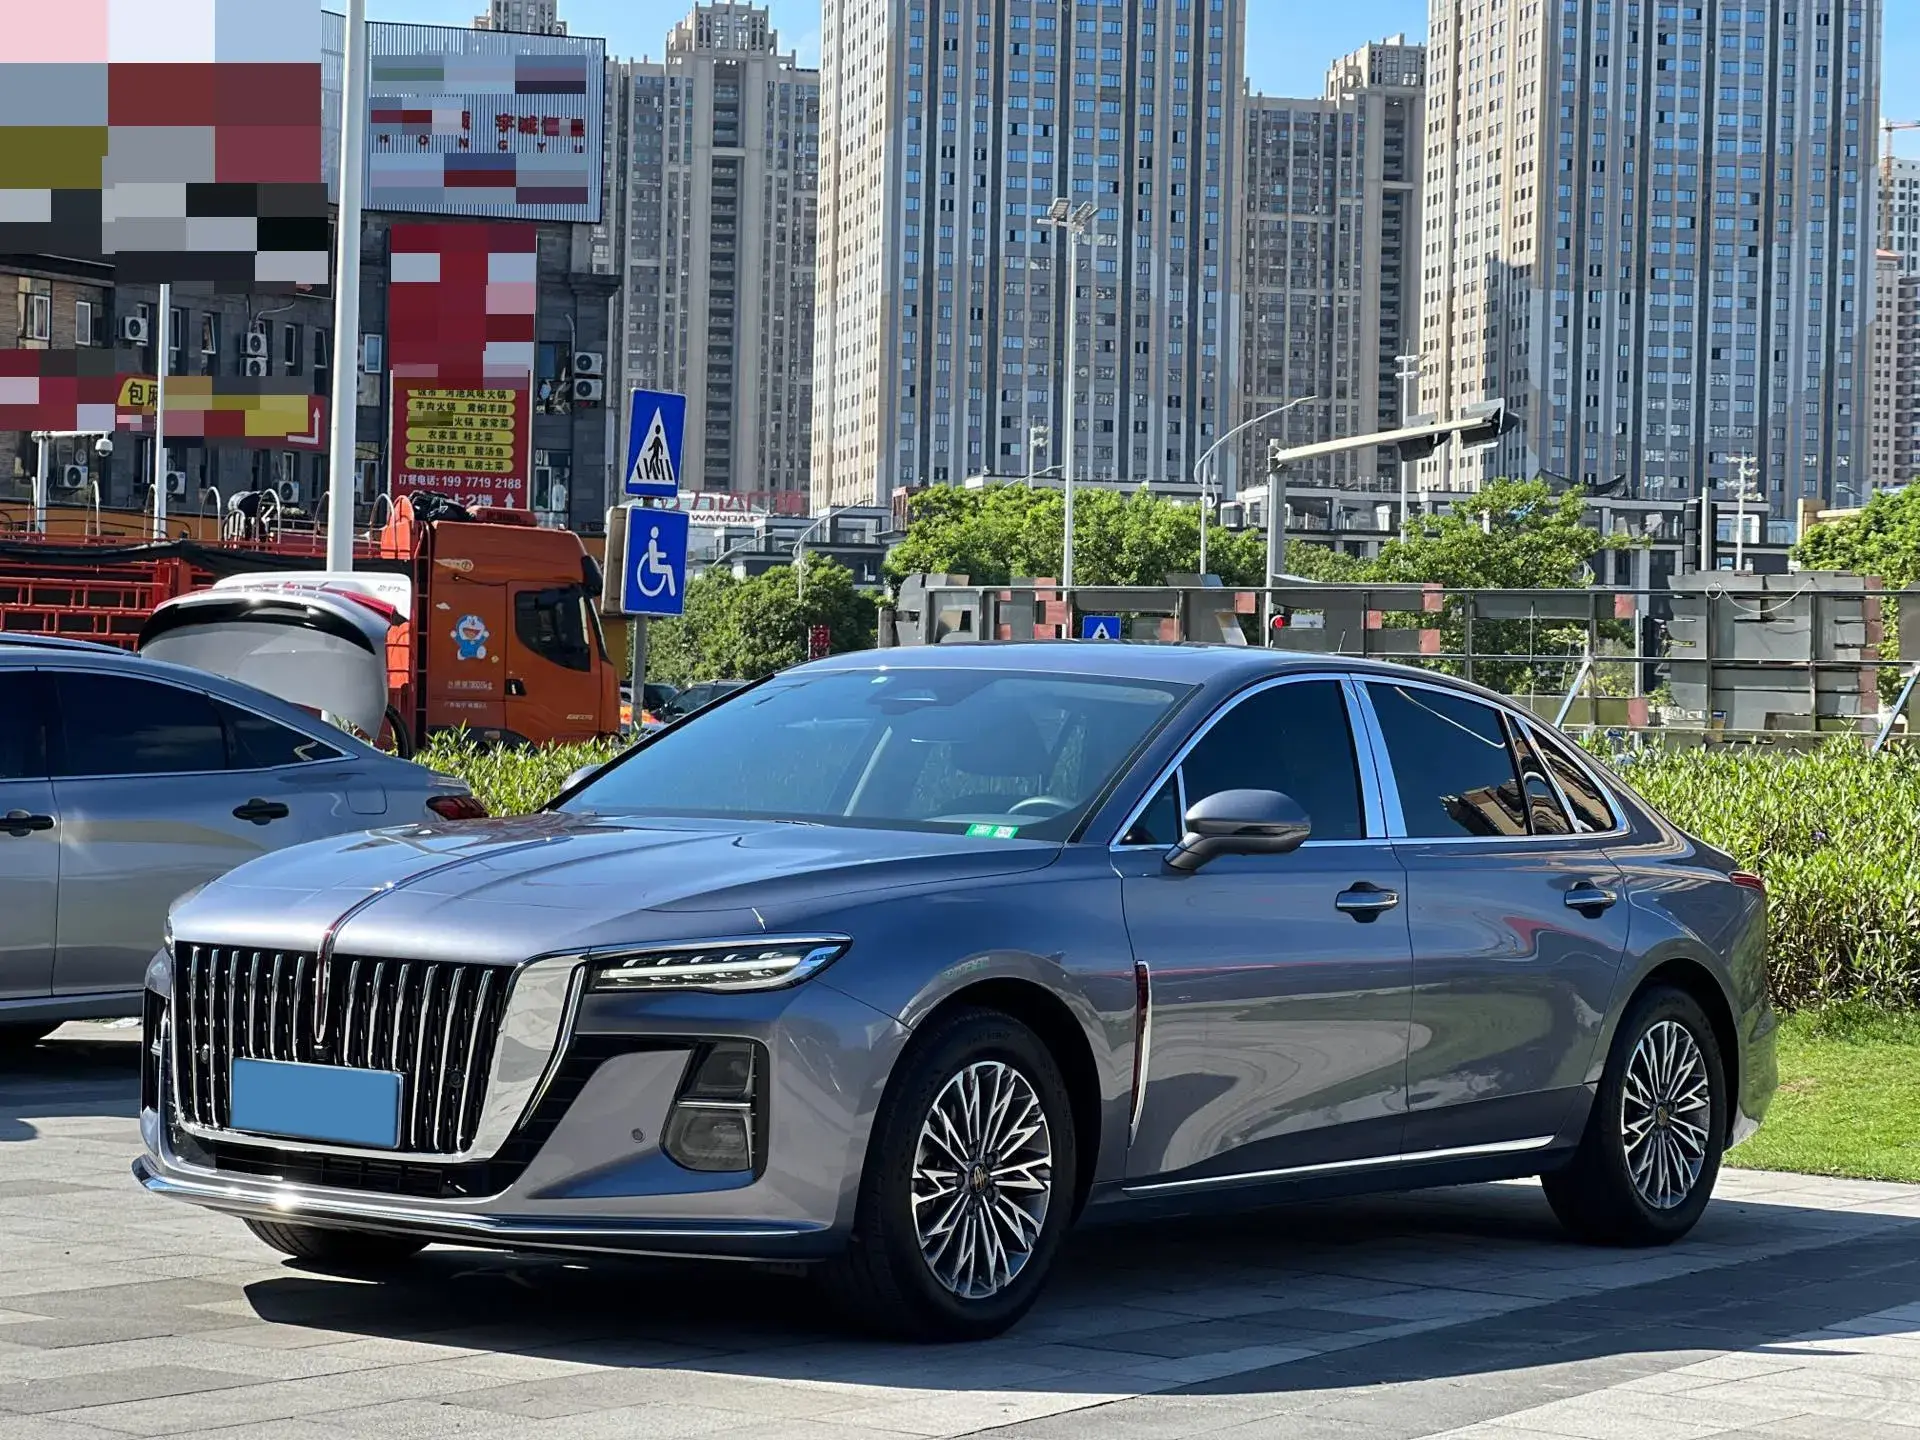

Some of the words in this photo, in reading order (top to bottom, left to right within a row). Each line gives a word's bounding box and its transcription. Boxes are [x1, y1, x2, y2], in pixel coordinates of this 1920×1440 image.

[416, 401, 456, 411] 羊肉火锅
[479, 417, 509, 428] 家常菜
[428, 430, 458, 441] 农家菜
[474, 446, 504, 457] 酸汤鱼
[415, 458, 456, 469] 酸汤牛肉
[442, 475, 462, 488] 199
[466, 477, 491, 489] 7719
[495, 478, 522, 490] 2188
[691, 489, 803, 513] 万达广
